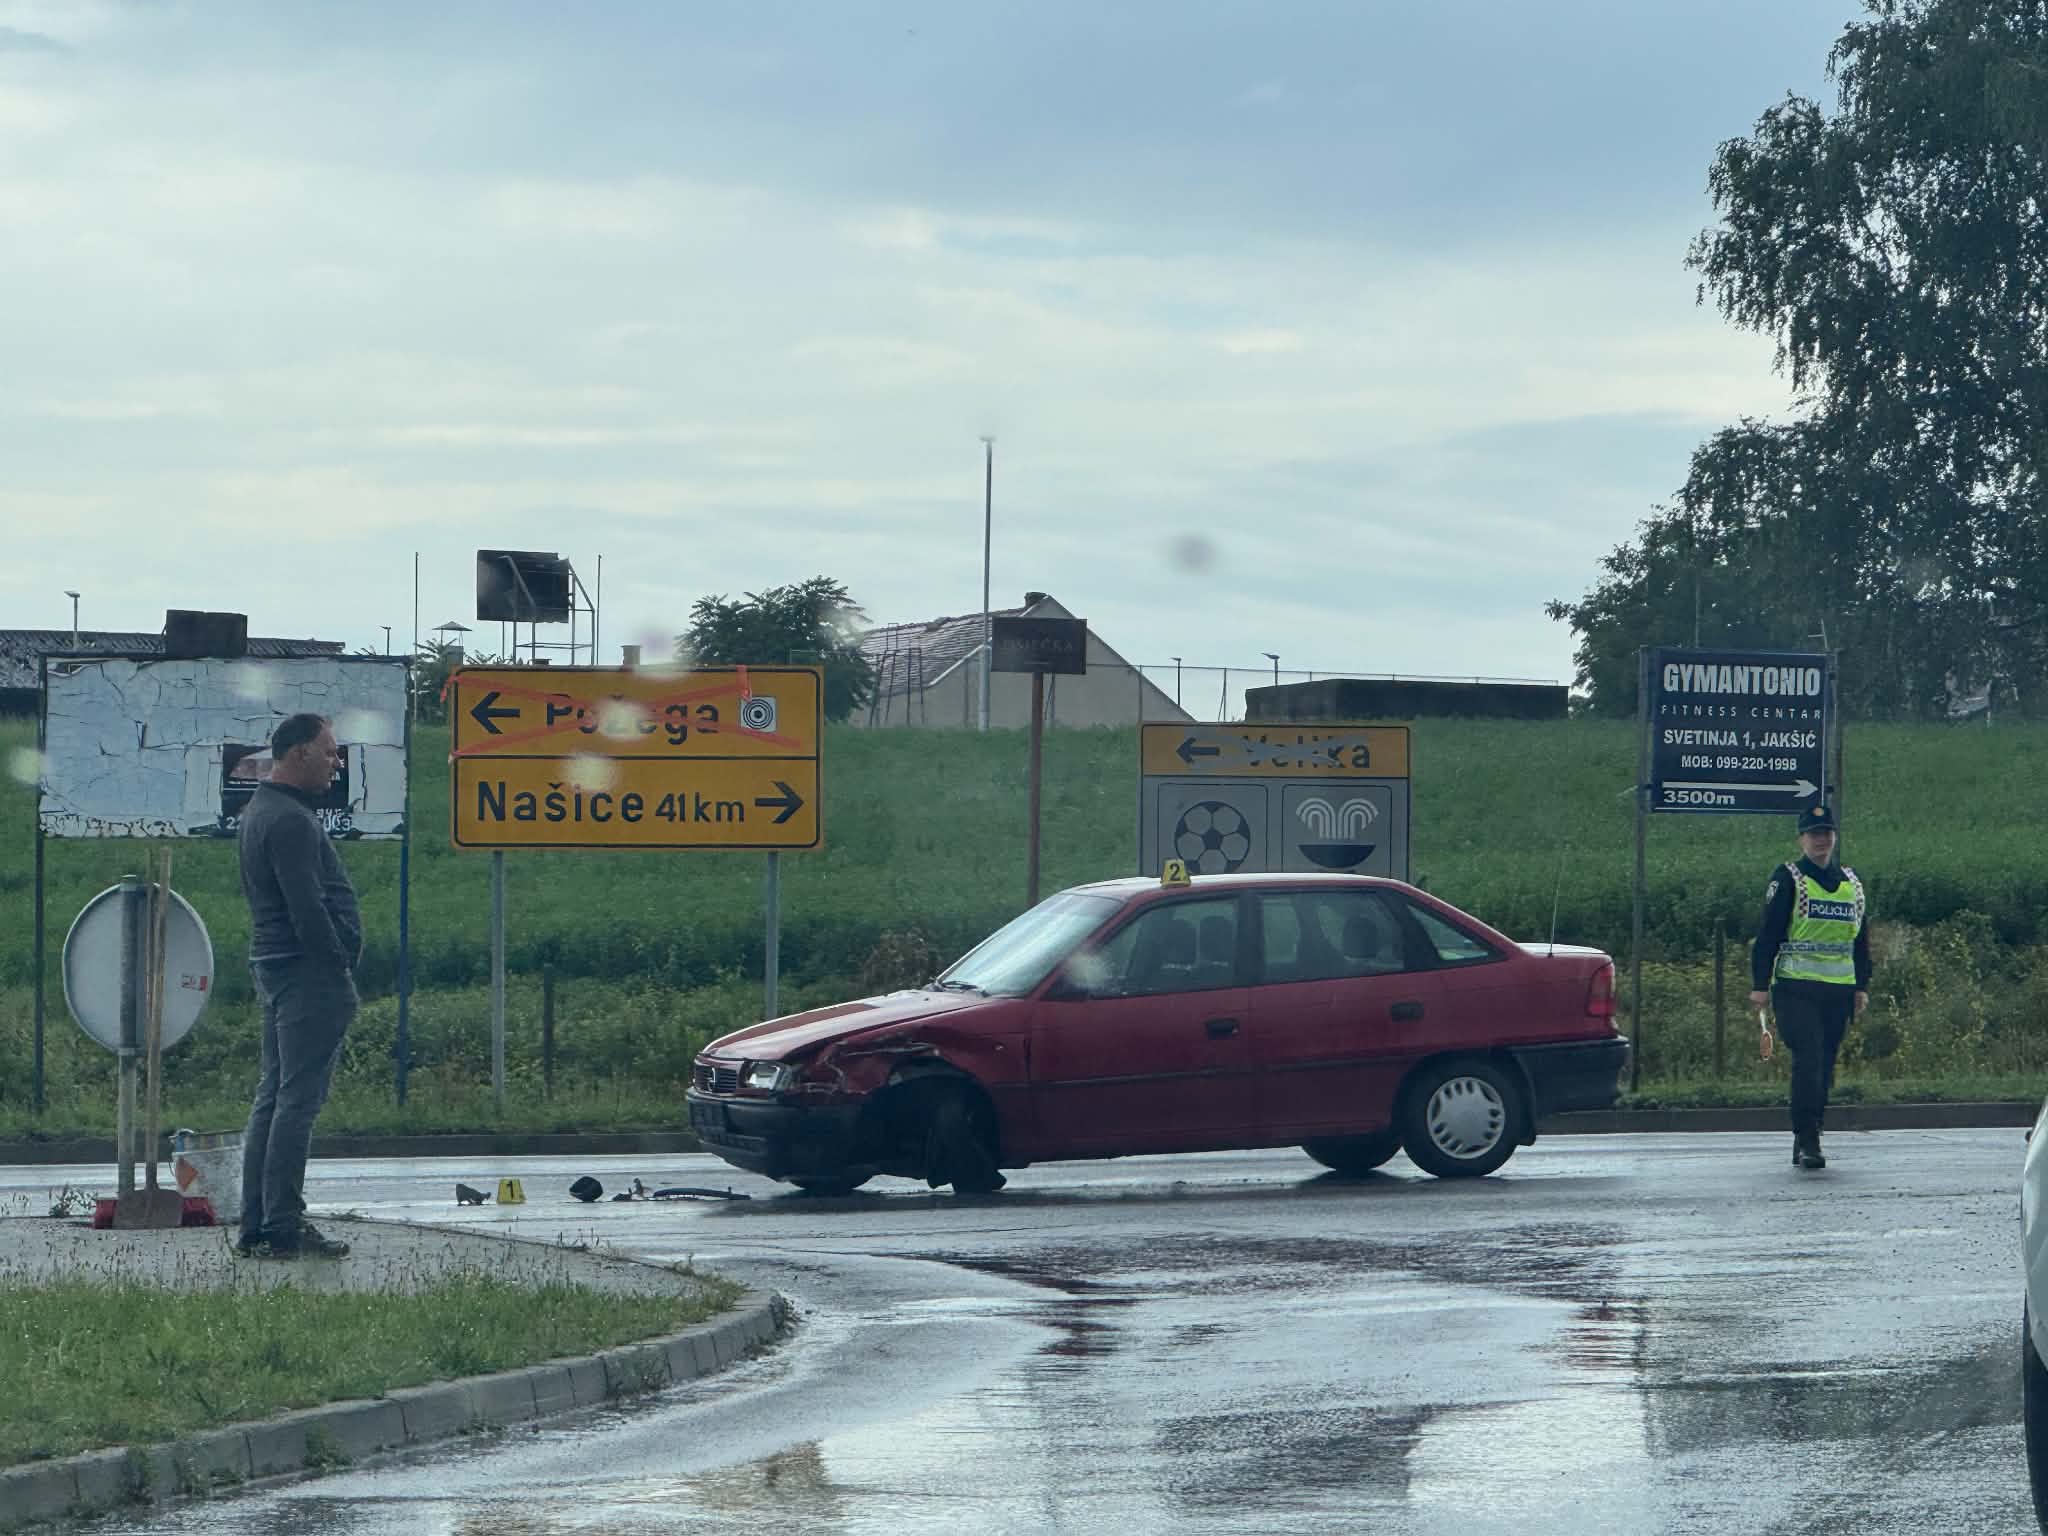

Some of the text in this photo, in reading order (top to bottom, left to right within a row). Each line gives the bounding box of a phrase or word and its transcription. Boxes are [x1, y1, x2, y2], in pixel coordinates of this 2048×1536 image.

[1663, 663, 1820, 697] GYMANTONIO
[1660, 704, 1822, 720] FITNESS CENTAR
[1663, 729, 1738, 747] SVETINJA
[1760, 729, 1817, 750] JAKŠIĆ
[1681, 755, 1713, 769] MOB:
[477, 780, 643, 823] Našice
[1663, 790, 1736, 805] 3500m
[1169, 863, 1181, 881] 2
[1810, 903, 1855, 918] POLICIJA
